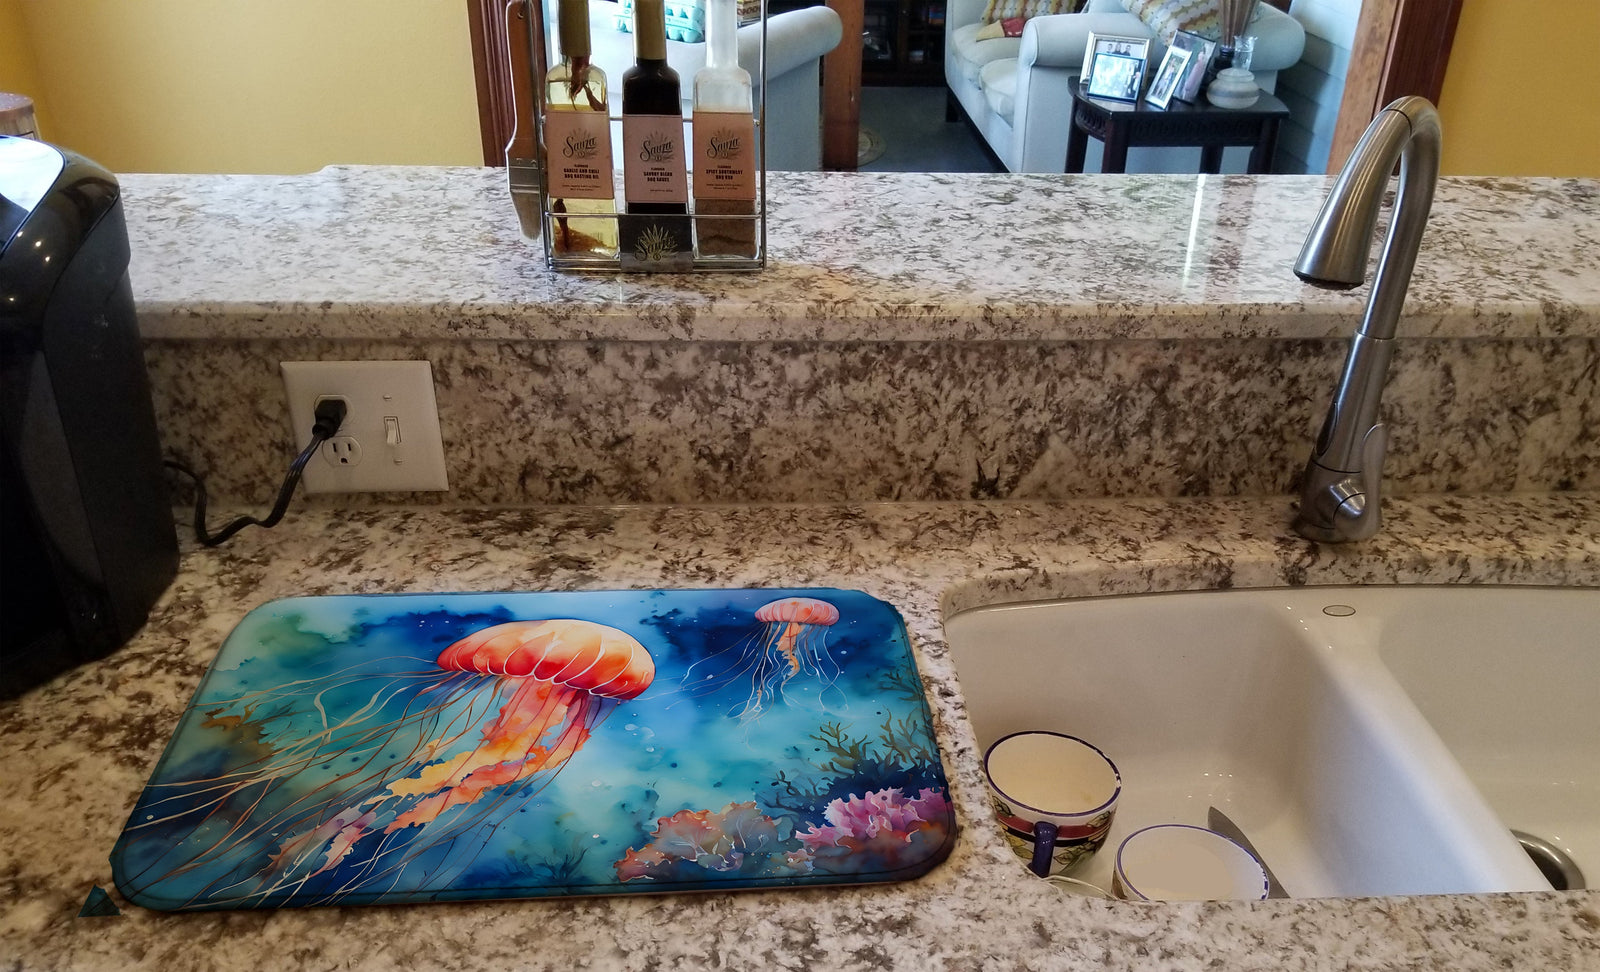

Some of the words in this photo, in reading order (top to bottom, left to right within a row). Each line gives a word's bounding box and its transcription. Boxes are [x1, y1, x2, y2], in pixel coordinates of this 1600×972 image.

[563, 136, 598, 158] Sauza
[640, 140, 673, 162] Sauza
[707, 136, 740, 159] Sauza
